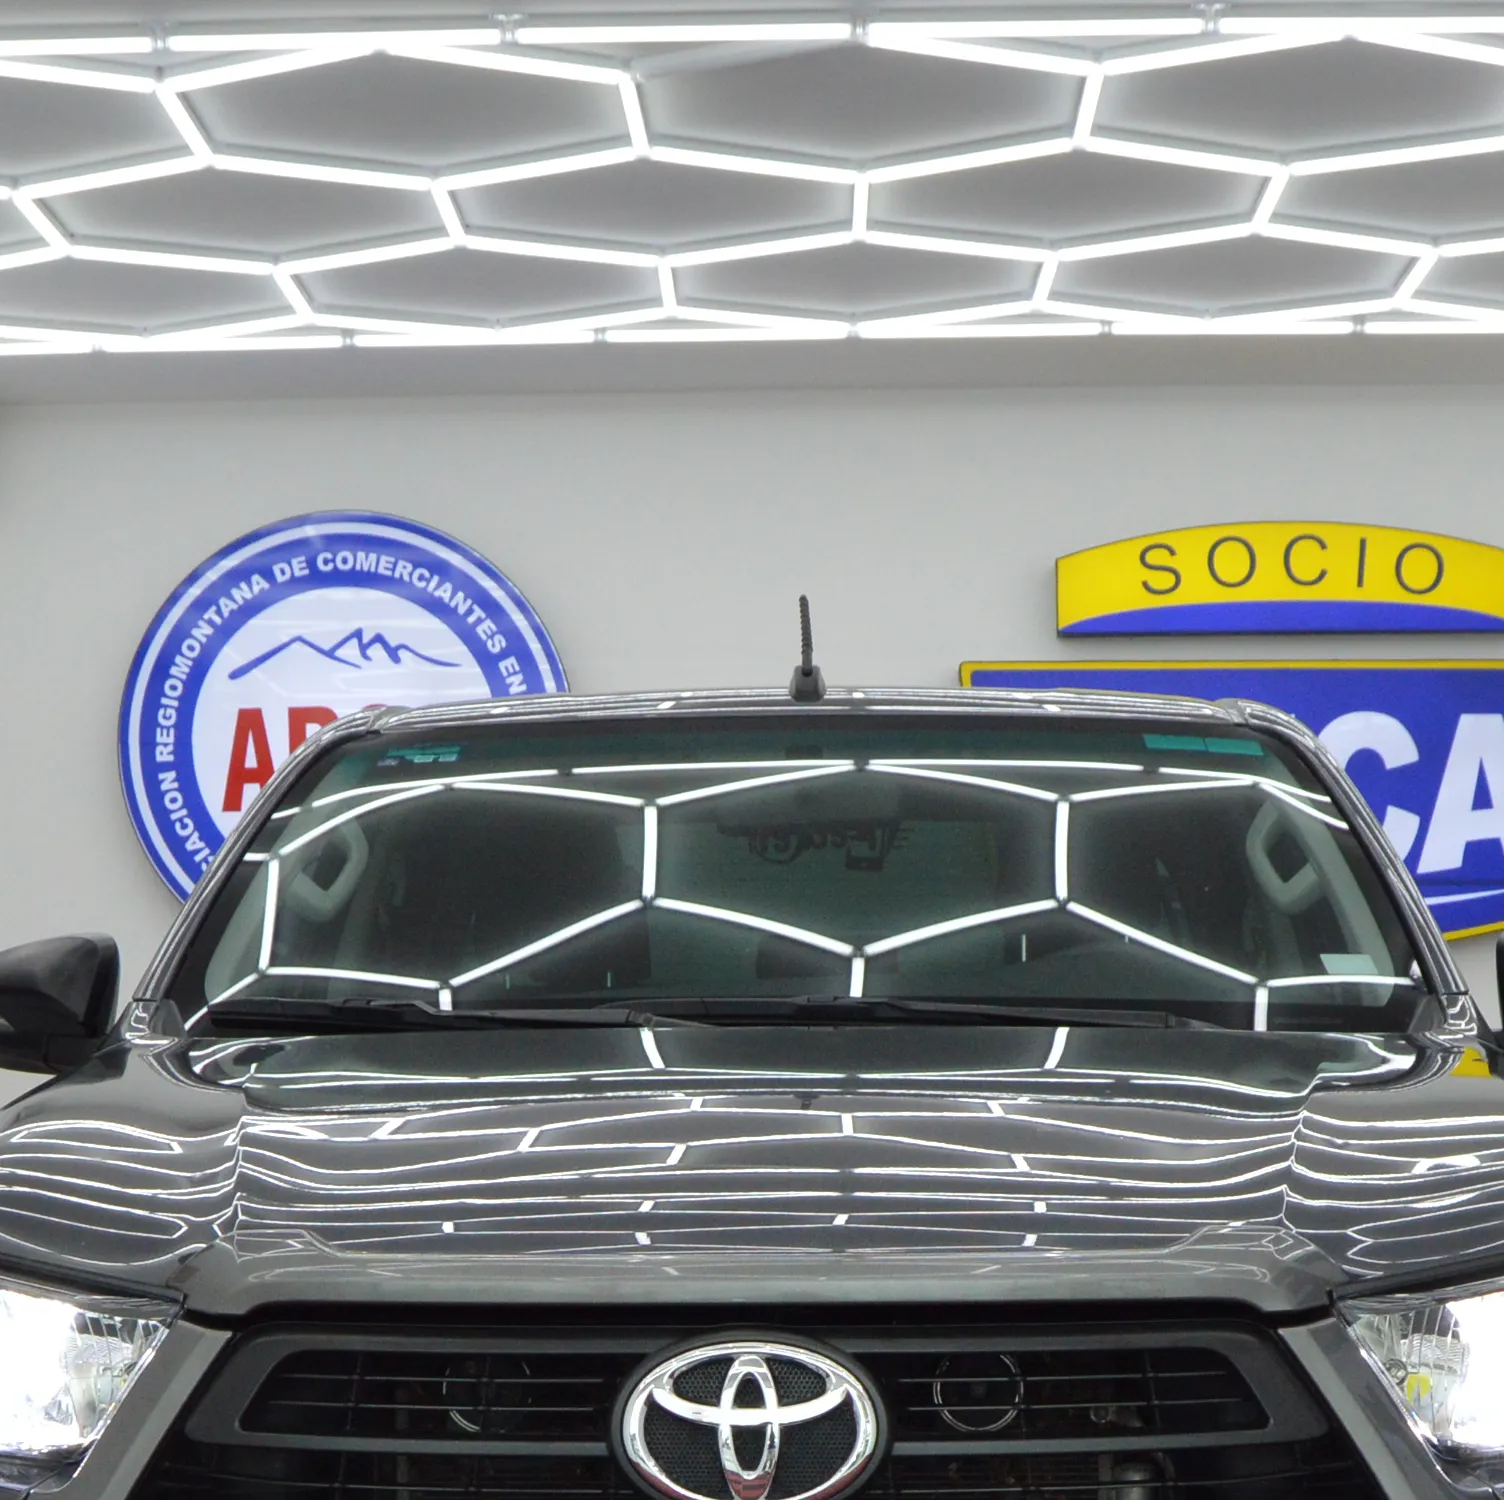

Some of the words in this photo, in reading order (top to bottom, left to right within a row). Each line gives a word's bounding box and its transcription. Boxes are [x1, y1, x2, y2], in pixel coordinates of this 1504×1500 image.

[272, 556, 309, 583] DE
[316, 551, 507, 654] COMERCIANTES
[1138, 533, 1445, 596] SOCIO
[155, 573, 270, 762] REGIOMONTANA
[498, 656, 527, 695] EN
[157, 770, 215, 872] IACION
